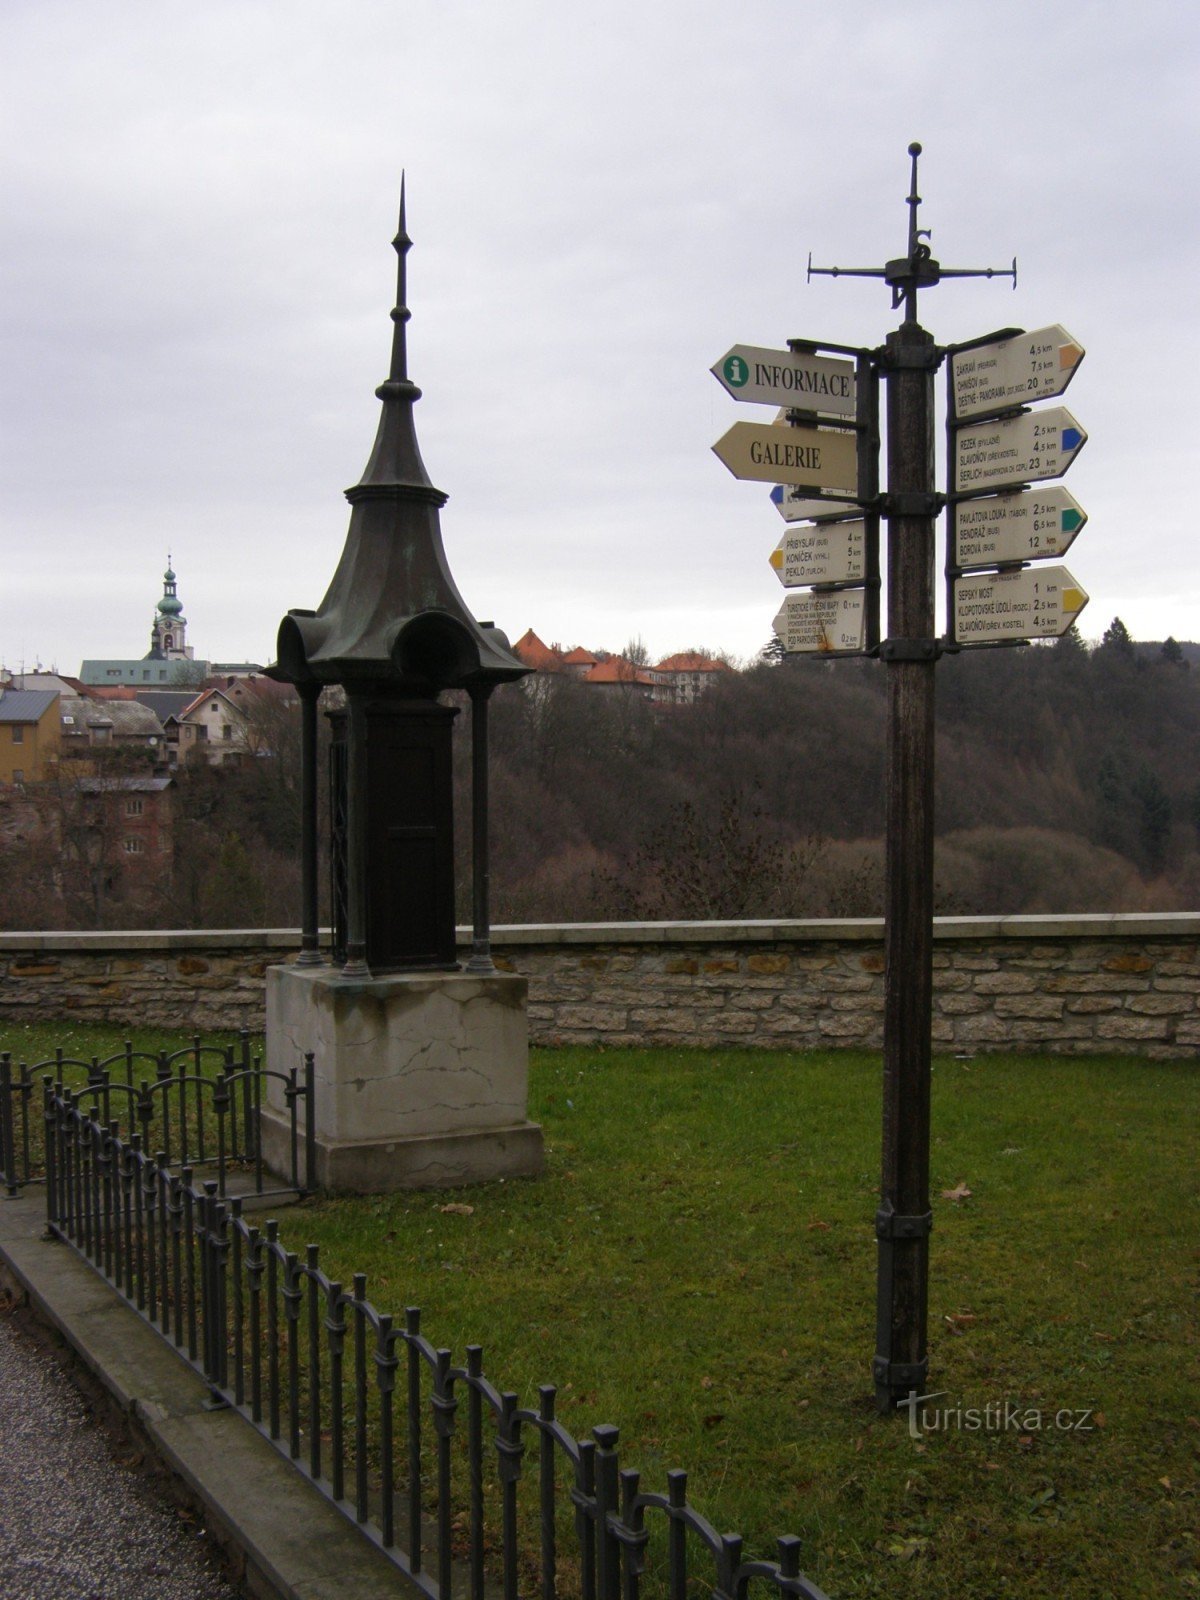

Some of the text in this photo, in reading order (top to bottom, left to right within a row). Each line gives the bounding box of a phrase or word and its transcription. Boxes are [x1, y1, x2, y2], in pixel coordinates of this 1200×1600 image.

[1030, 345, 1041, 356] 4,5
[1031, 361, 1042, 372] 7,5
[755, 363, 850, 398] INFORMACE
[1027, 377, 1038, 390] 20
[960, 438, 976, 450] REZEK
[1034, 426, 1046, 436] 2,5
[1033, 441, 1045, 452] 4,5
[751, 441, 822, 470] GALERIE
[1029, 457, 1040, 469] 23
[989, 508, 1006, 521] LOUKA
[1033, 504, 1045, 515] 2,5
[960, 525, 985, 540] SENDRÁŽ
[1033, 520, 1045, 531] 6,5
[787, 537, 815, 550] PŘIBYSLAV
[848, 532, 852, 542] 4
[1029, 536, 1039, 548] 12
[1046, 536, 1056, 544] km
[786, 550, 812, 564] KONÍČEK
[848, 547, 852, 557] 5
[786, 566, 805, 577] PEKLO
[848, 561, 852, 571] 7
[979, 587, 993, 598] MOST
[1034, 583, 1038, 593] 1
[1034, 600, 1045, 610] 2,5
[959, 618, 985, 632] SLAVOŇOV
[1033, 616, 1045, 627] 4,5
